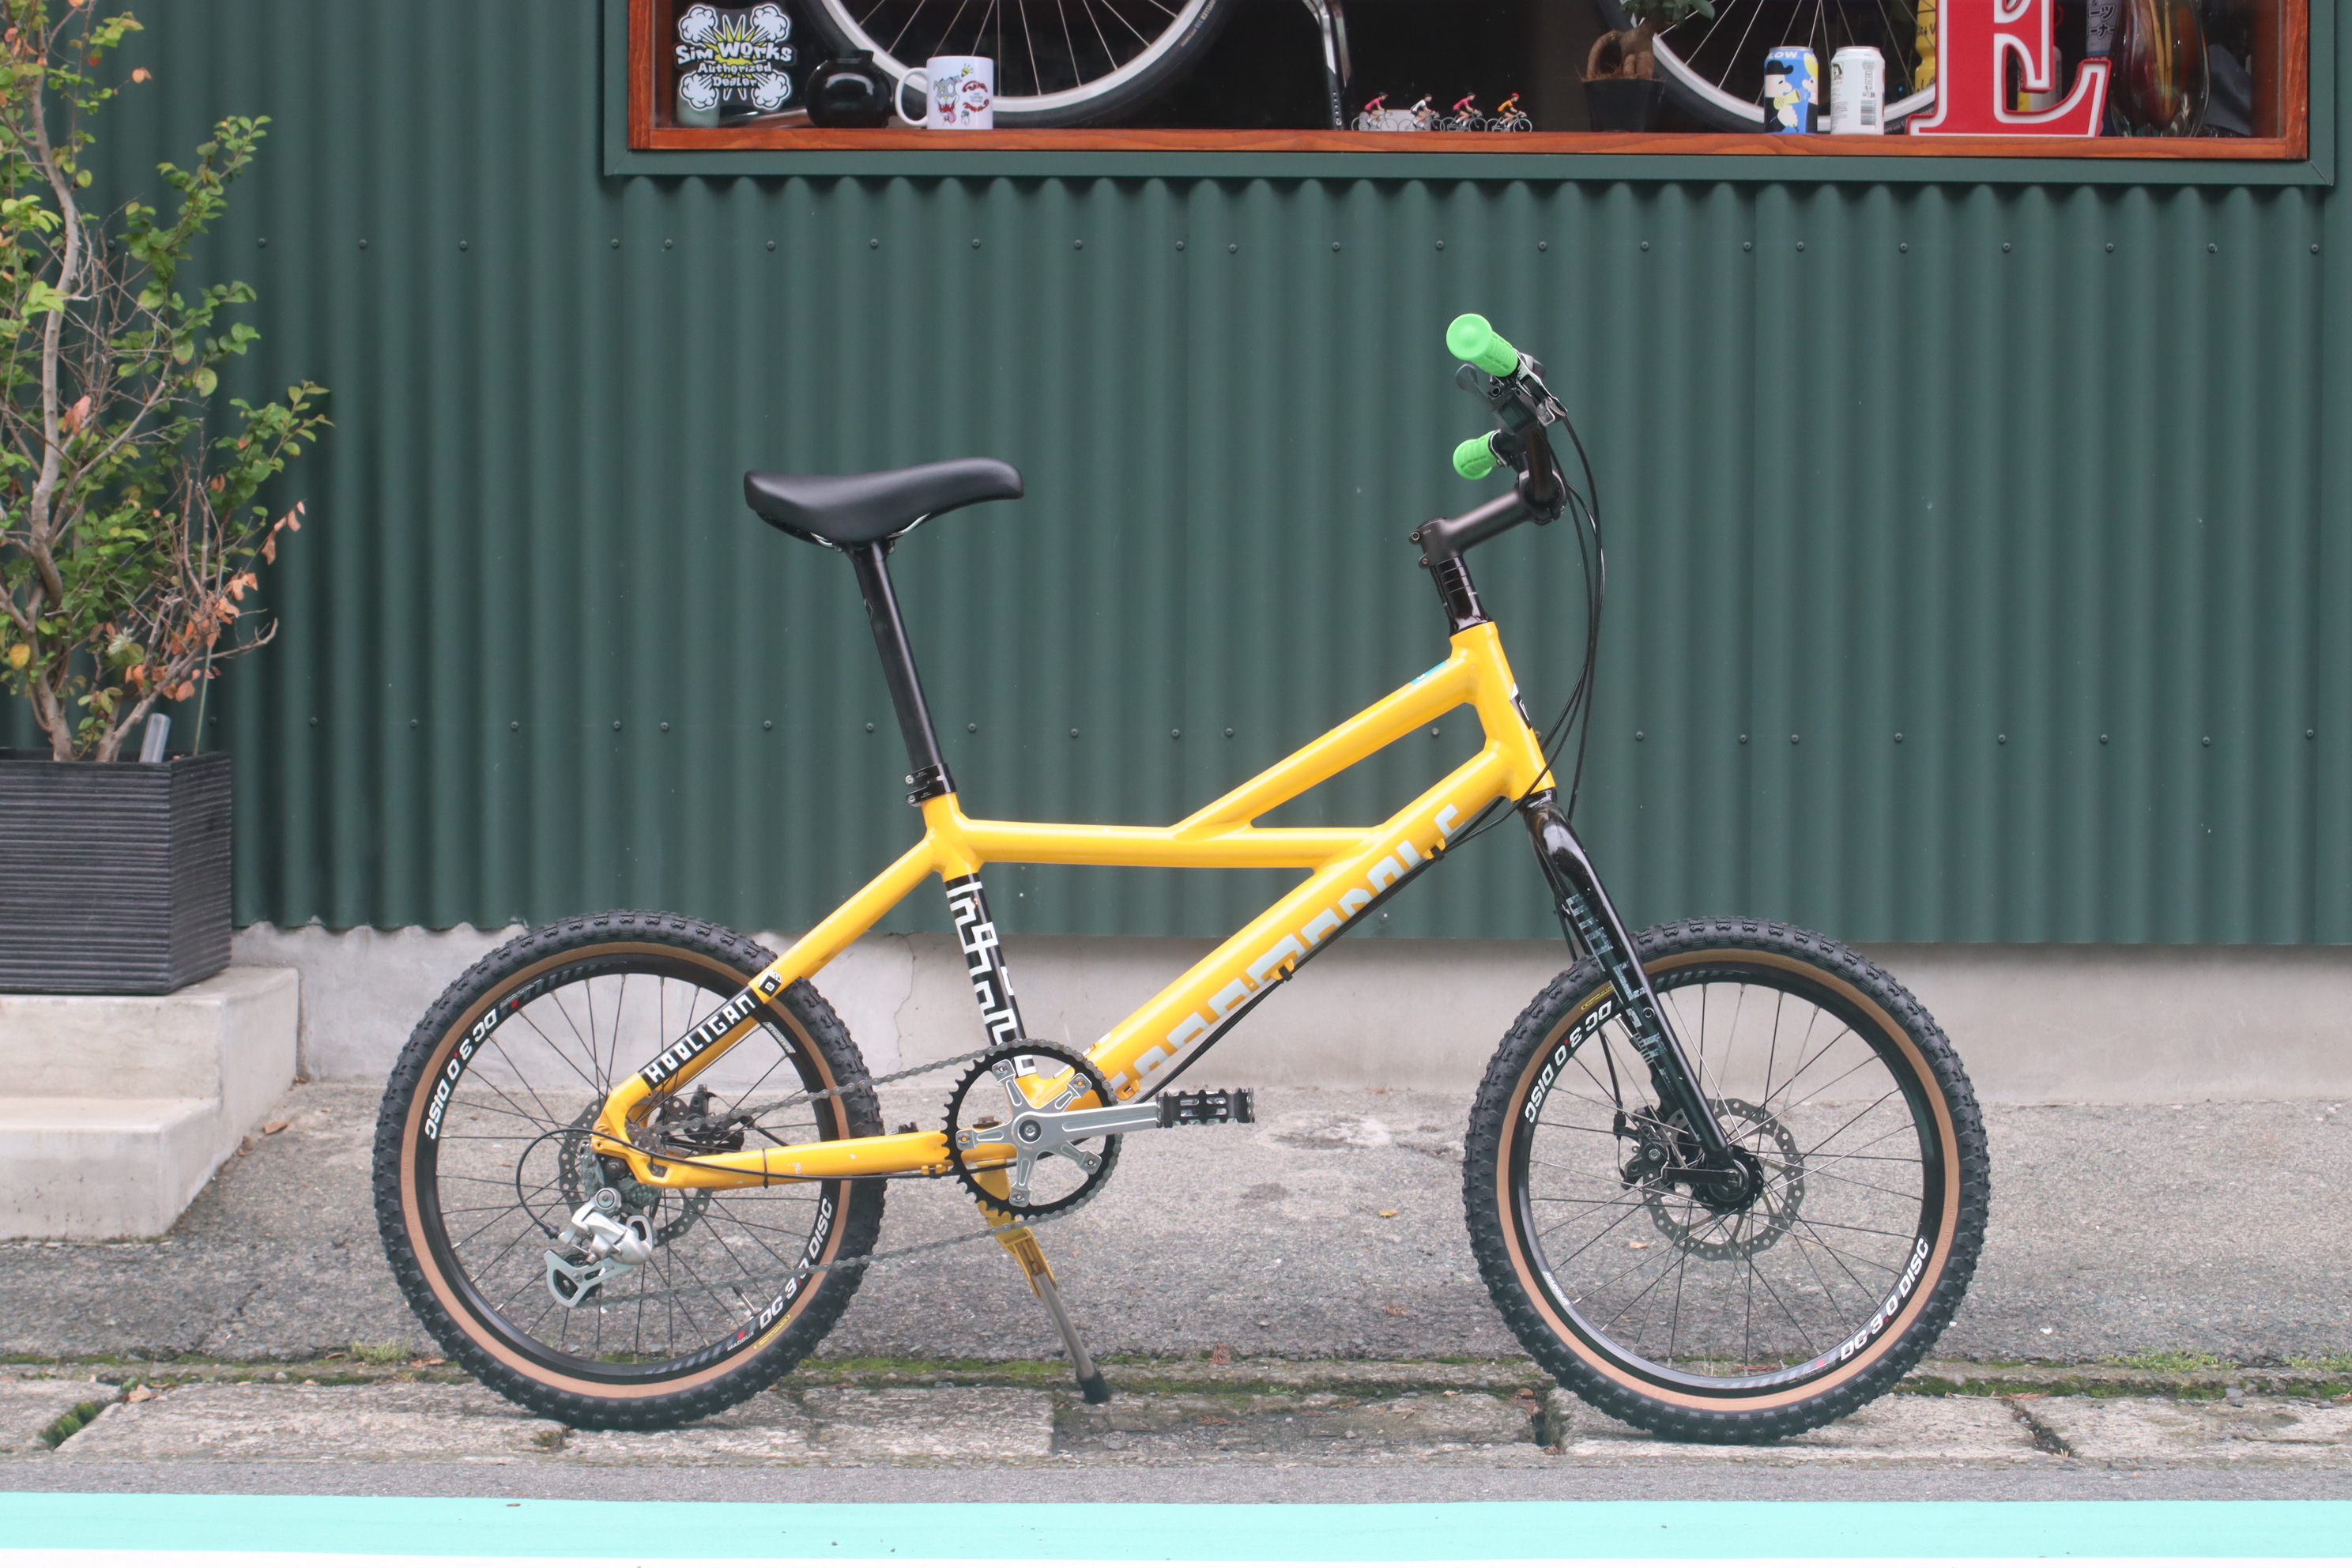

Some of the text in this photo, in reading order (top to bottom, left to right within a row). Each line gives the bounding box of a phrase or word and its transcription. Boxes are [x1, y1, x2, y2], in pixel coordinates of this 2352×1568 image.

[2087, 4, 2115, 21] ーツ
[697, 62, 772, 74] Authorized
[718, 41, 793, 62] Works
[712, 76, 758, 88] Dealer
[1585, 1000, 1612, 1031] DC
[643, 993, 756, 1084] HOOLIGAN
[1555, 1026, 1582, 1067] 3.0
[424, 1008, 498, 1140] DC 3.0 DISC
[1525, 1063, 1555, 1124] DISC
[760, 1295, 783, 1329] DC
[808, 1197, 832, 1259] DISC
[1841, 1237, 1929, 1361] DC 3.0 DISC
